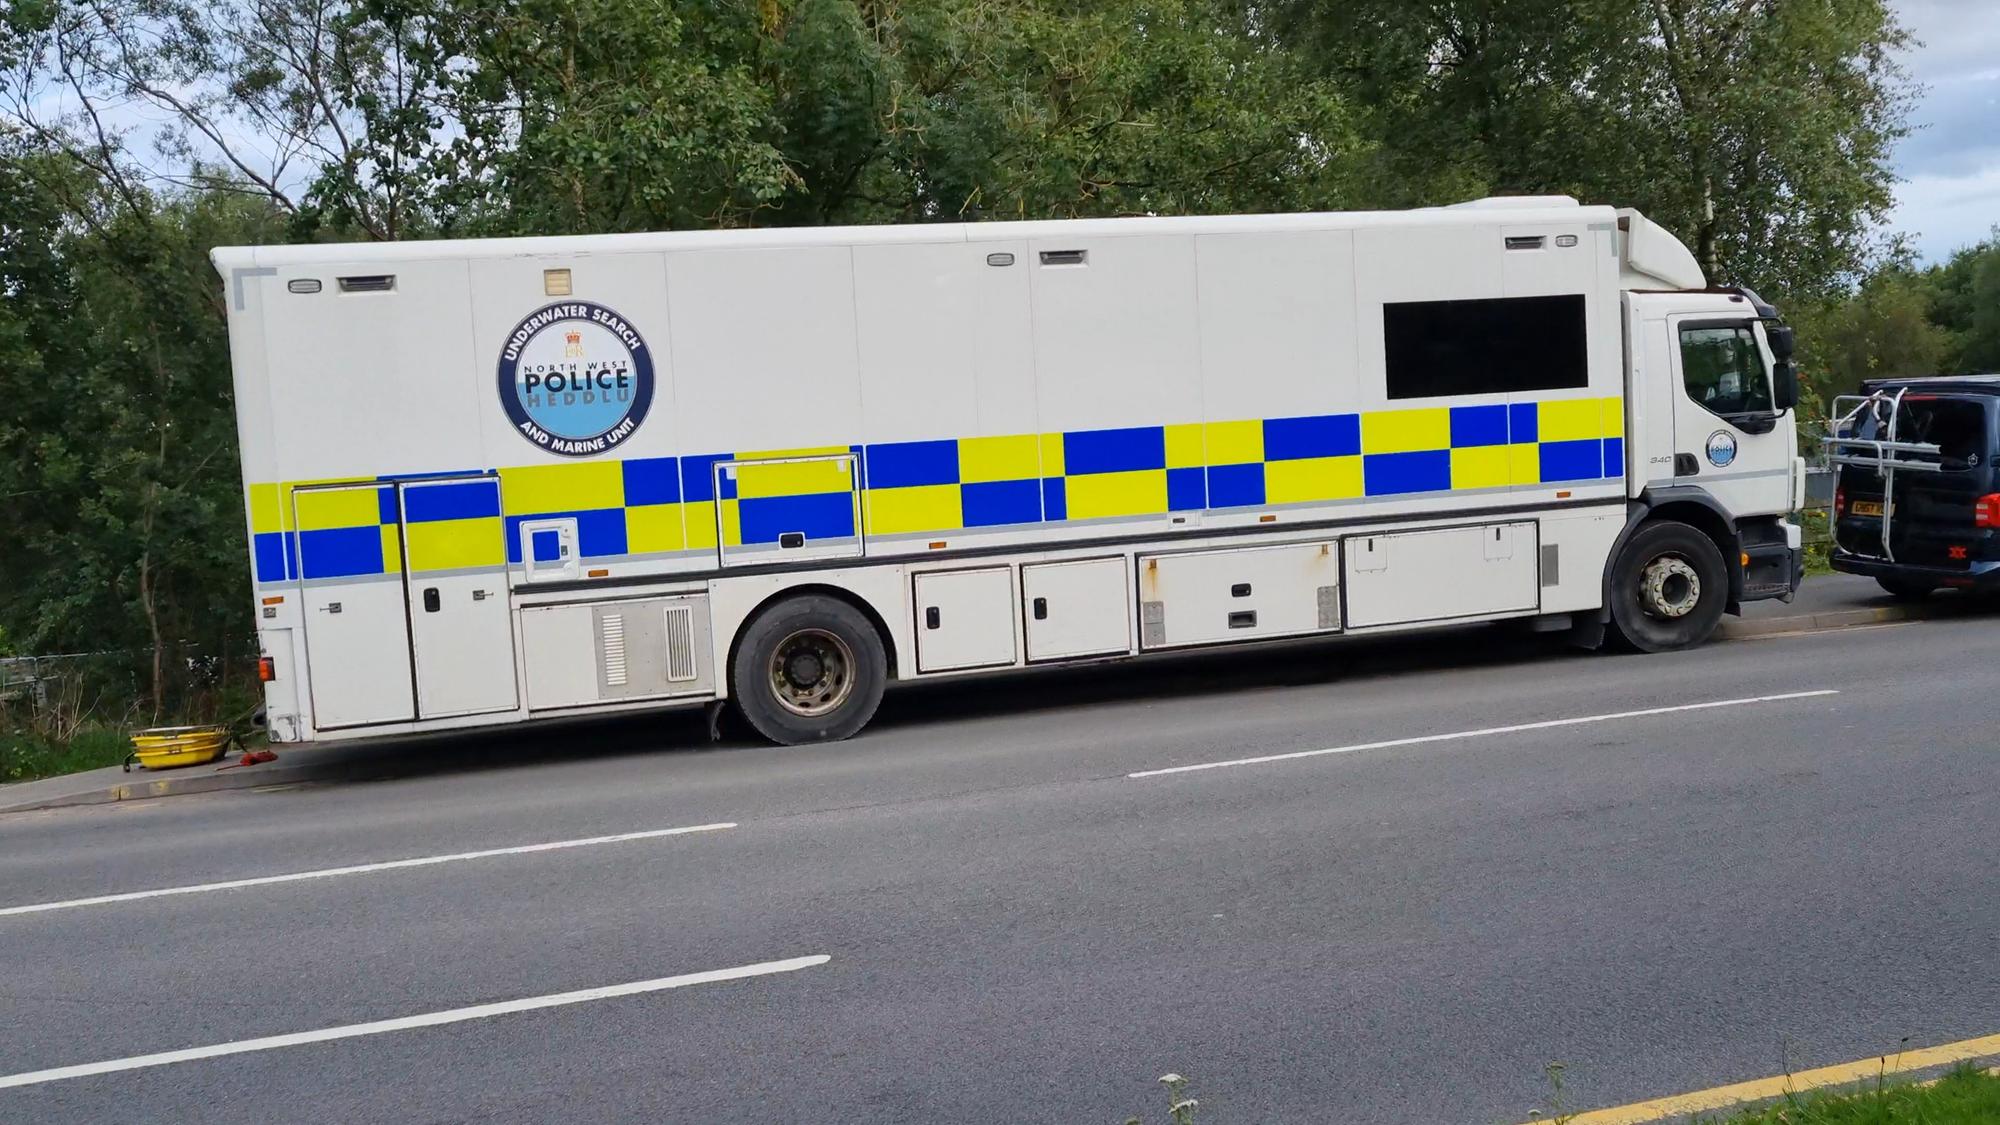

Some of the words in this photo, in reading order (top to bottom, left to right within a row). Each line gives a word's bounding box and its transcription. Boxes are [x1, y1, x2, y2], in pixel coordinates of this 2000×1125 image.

[505, 305, 587, 361] UNDERWATER
[592, 309, 641, 350] SEARCH
[524, 363, 577, 373] NORTH
[588, 360, 627, 370] WEST
[524, 369, 629, 394] POLICE
[527, 389, 629, 408] HEDDLU
[520, 421, 549, 444] AND
[551, 438, 606, 453] MARINE
[606, 417, 635, 443] UNIT
[1649, 456, 1672, 464] 340
